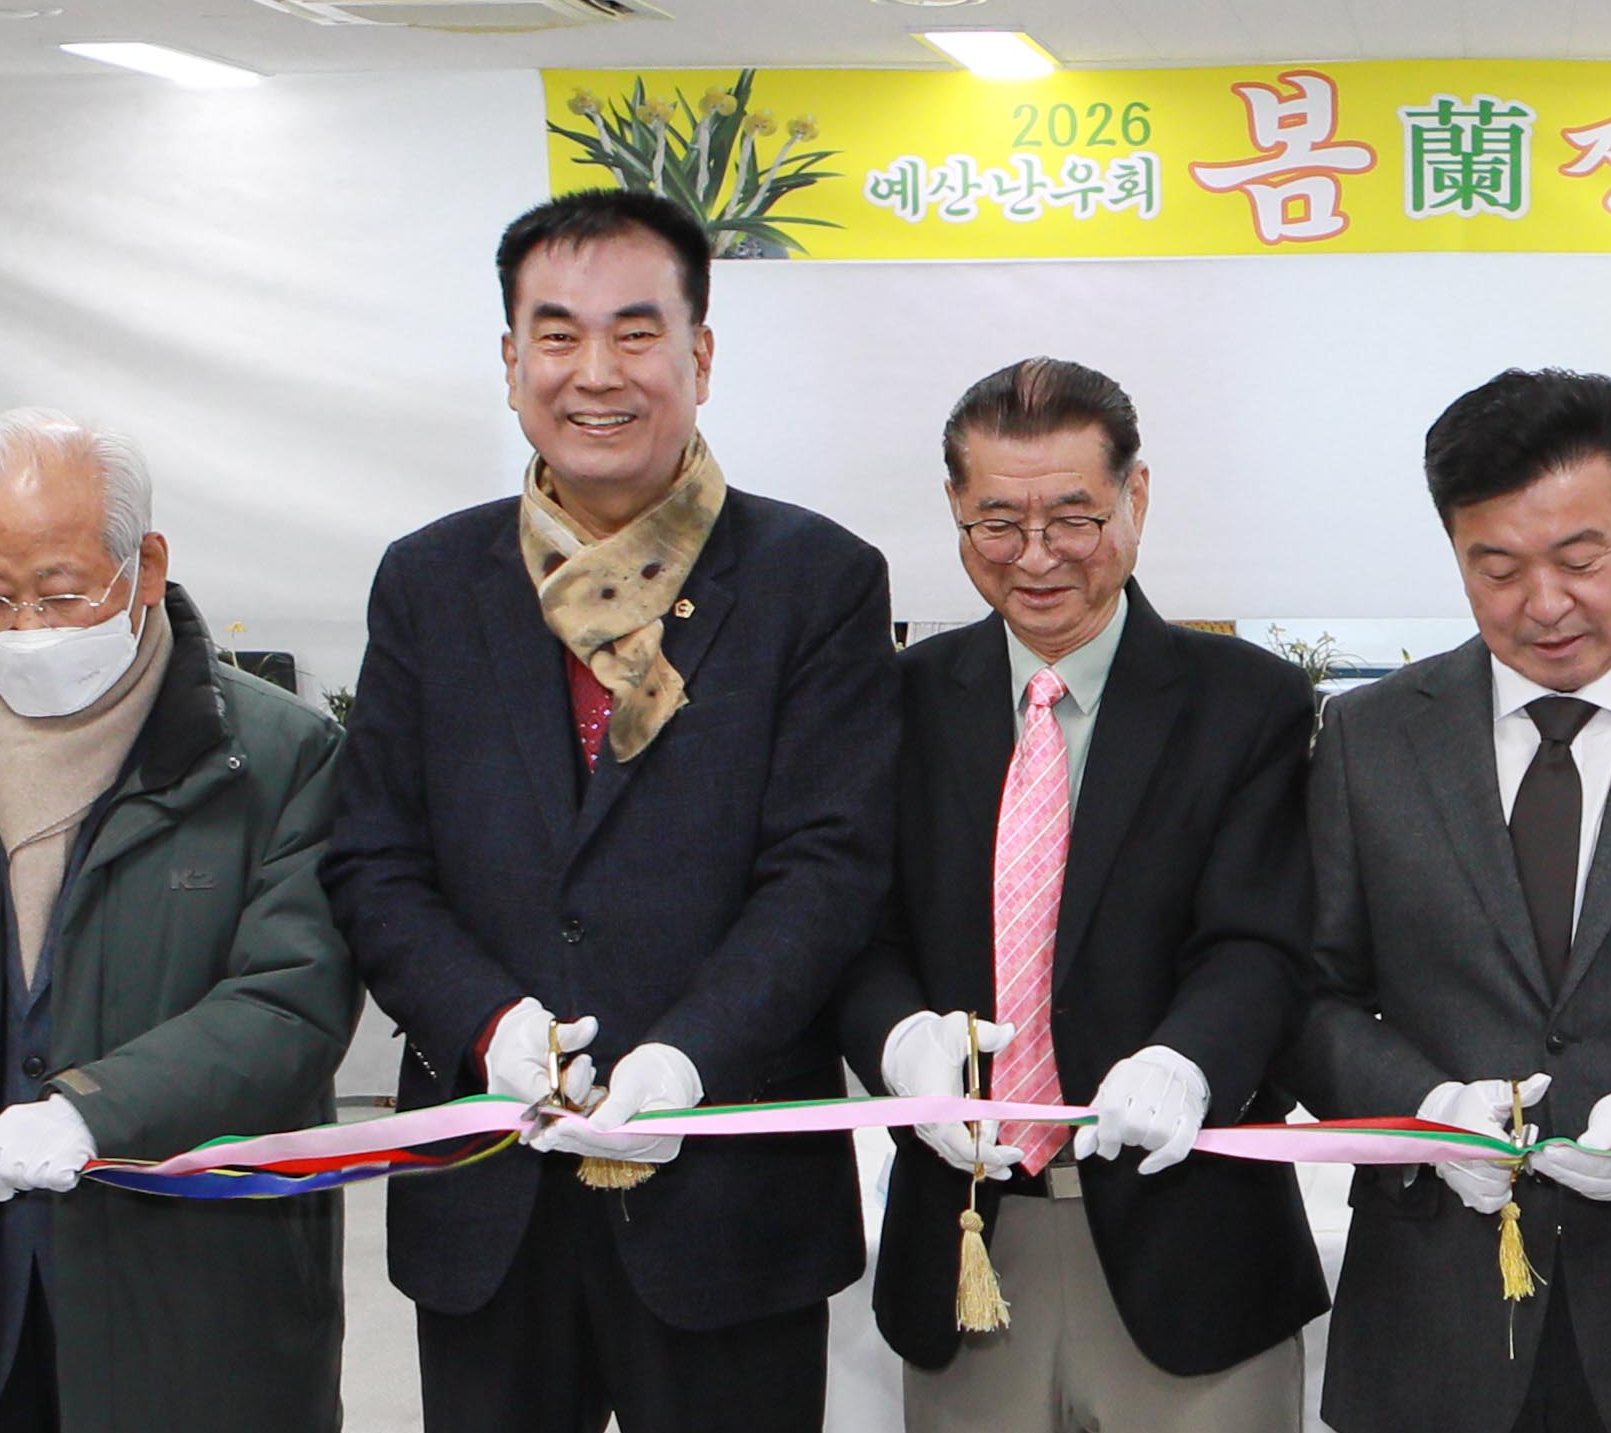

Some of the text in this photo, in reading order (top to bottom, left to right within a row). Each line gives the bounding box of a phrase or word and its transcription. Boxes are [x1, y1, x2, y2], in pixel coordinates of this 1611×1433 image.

[1012, 101, 1152, 148] 2026
[869, 155, 1156, 218] 예산난우회
[1188, 69, 1378, 246] 봄
[1400, 96, 1535, 216] 蘭
